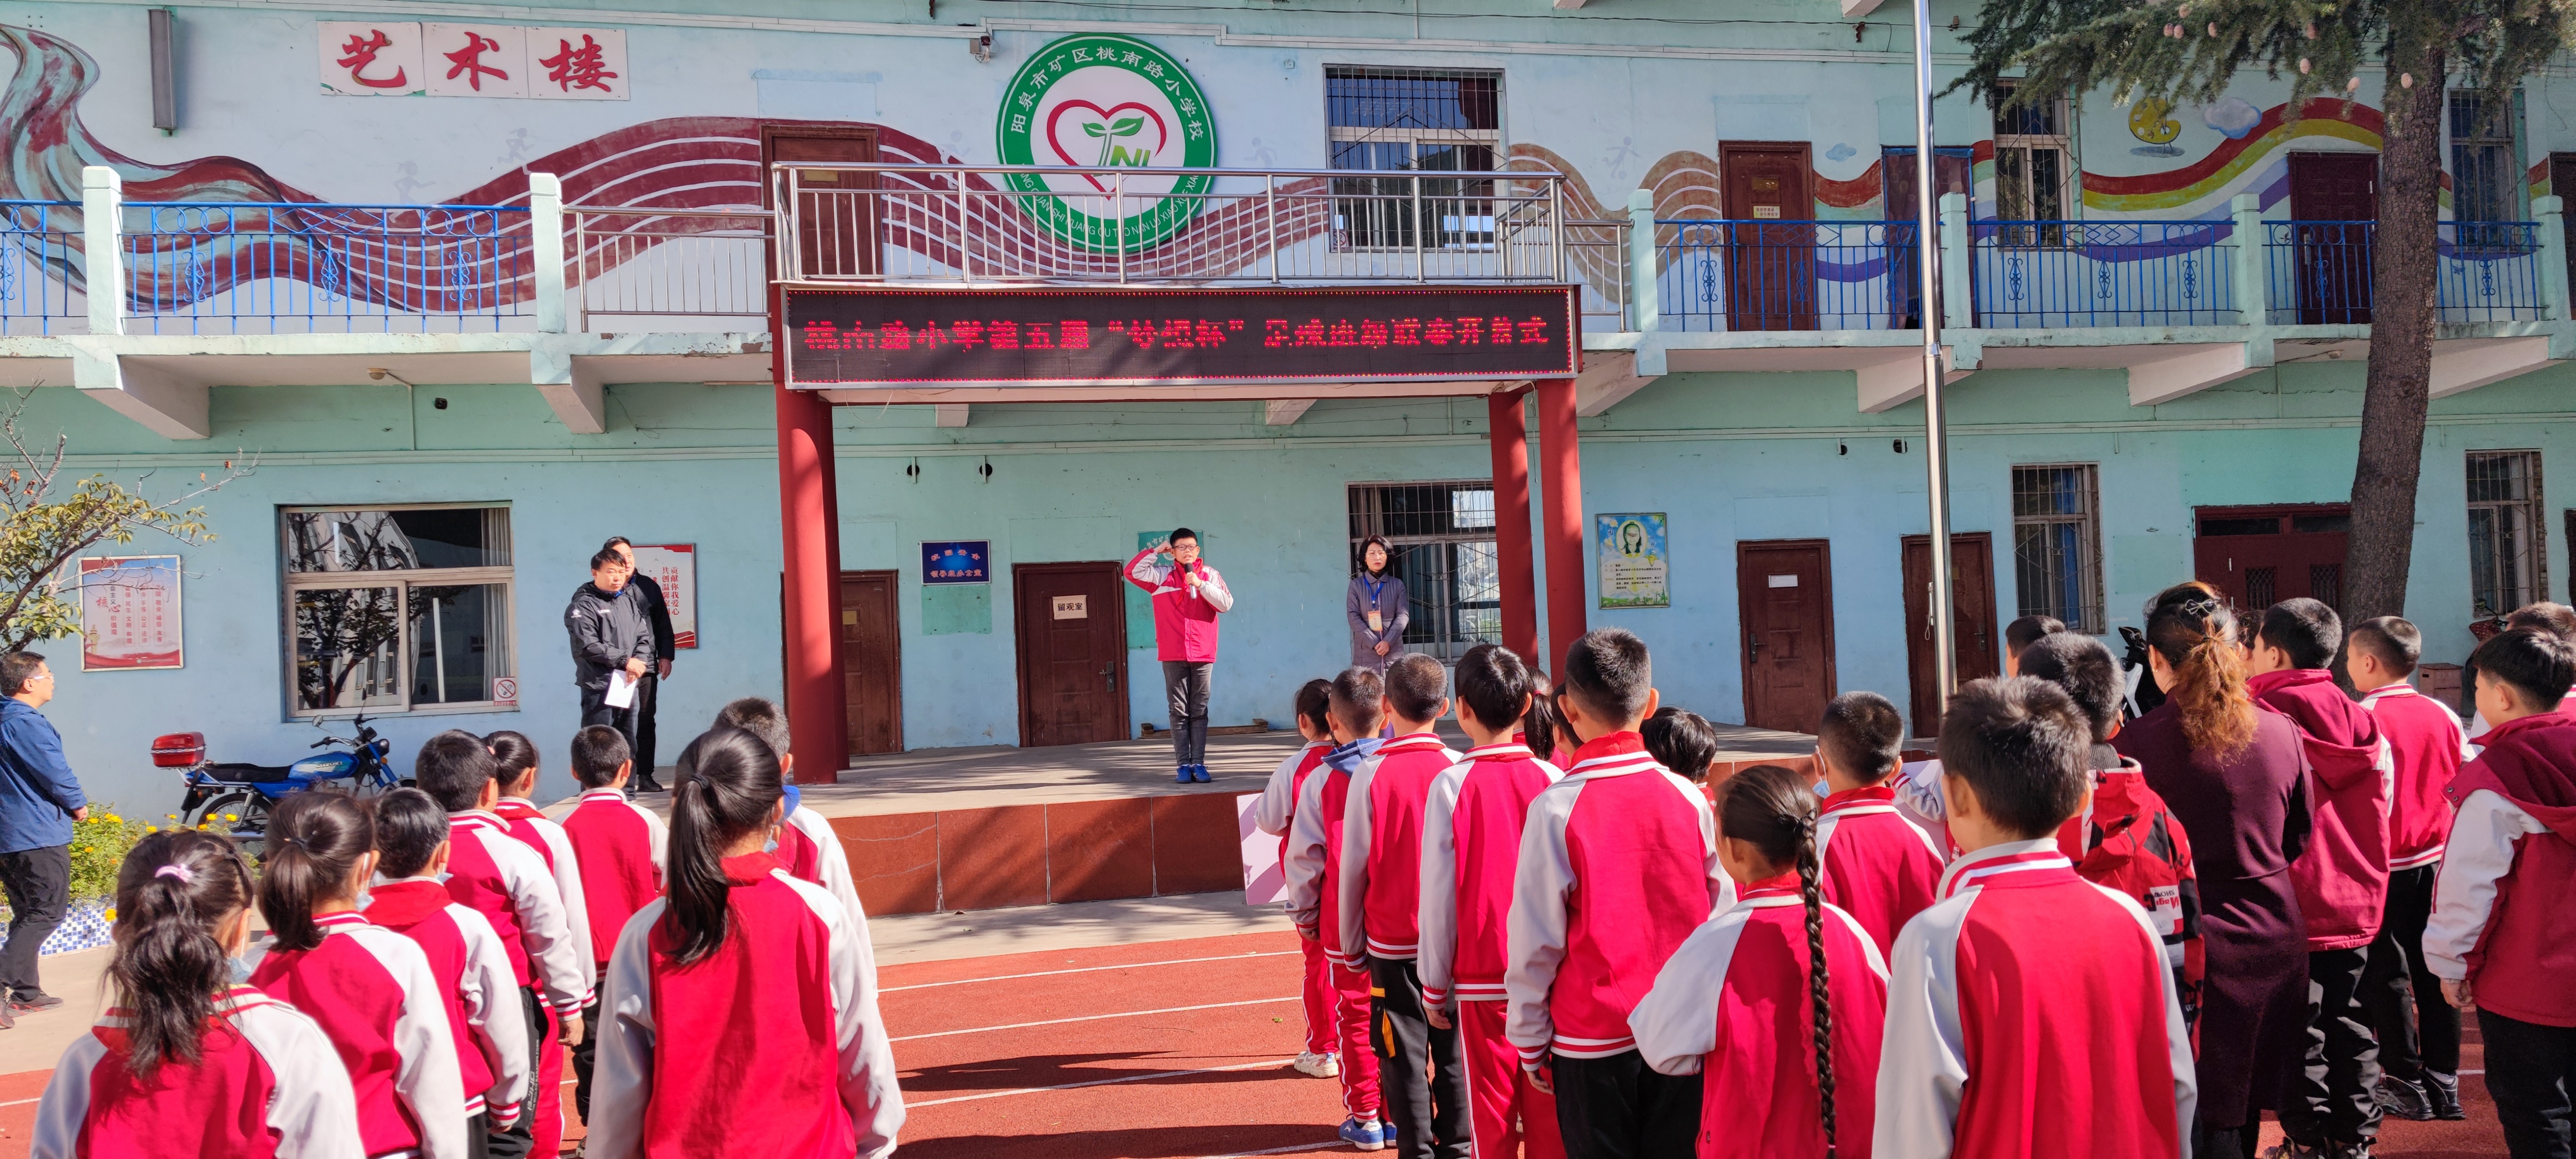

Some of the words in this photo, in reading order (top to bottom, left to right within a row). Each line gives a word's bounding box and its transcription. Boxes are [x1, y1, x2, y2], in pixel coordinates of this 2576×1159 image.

[337, 29, 618, 92] 艺术楼
[1011, 46, 1203, 141] 阳泉市矿区桃南路小学校
[1052, 208, 1066, 223] SHI
[671, 567, 679, 615] 贡献你我爱心
[1058, 602, 1083, 612] 留观室
